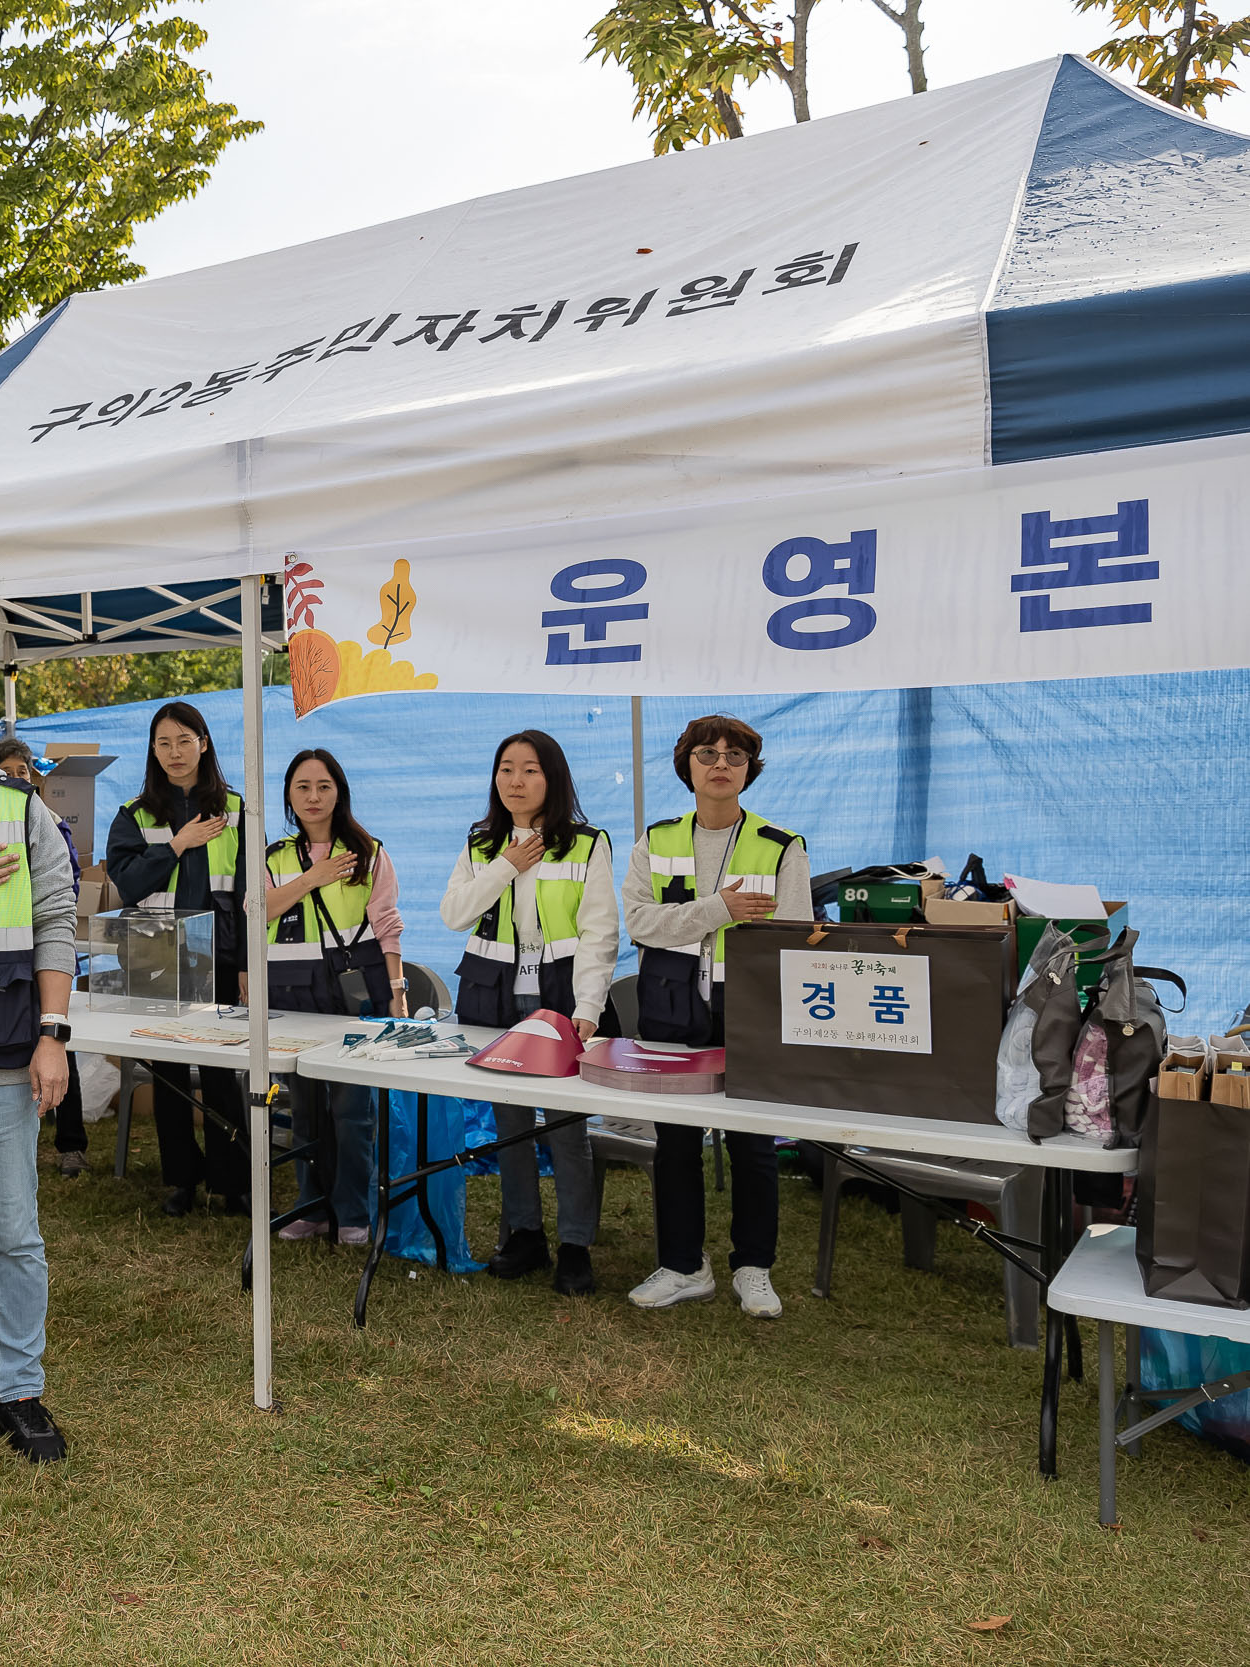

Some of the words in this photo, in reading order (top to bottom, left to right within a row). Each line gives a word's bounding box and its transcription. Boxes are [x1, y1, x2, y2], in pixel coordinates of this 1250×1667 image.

[844, 888, 869, 902] 80
[519, 964, 540, 976] AFF
[792, 1027, 839, 1040] 구의제2동
[845, 1030, 919, 1046] 문화행사위원회
